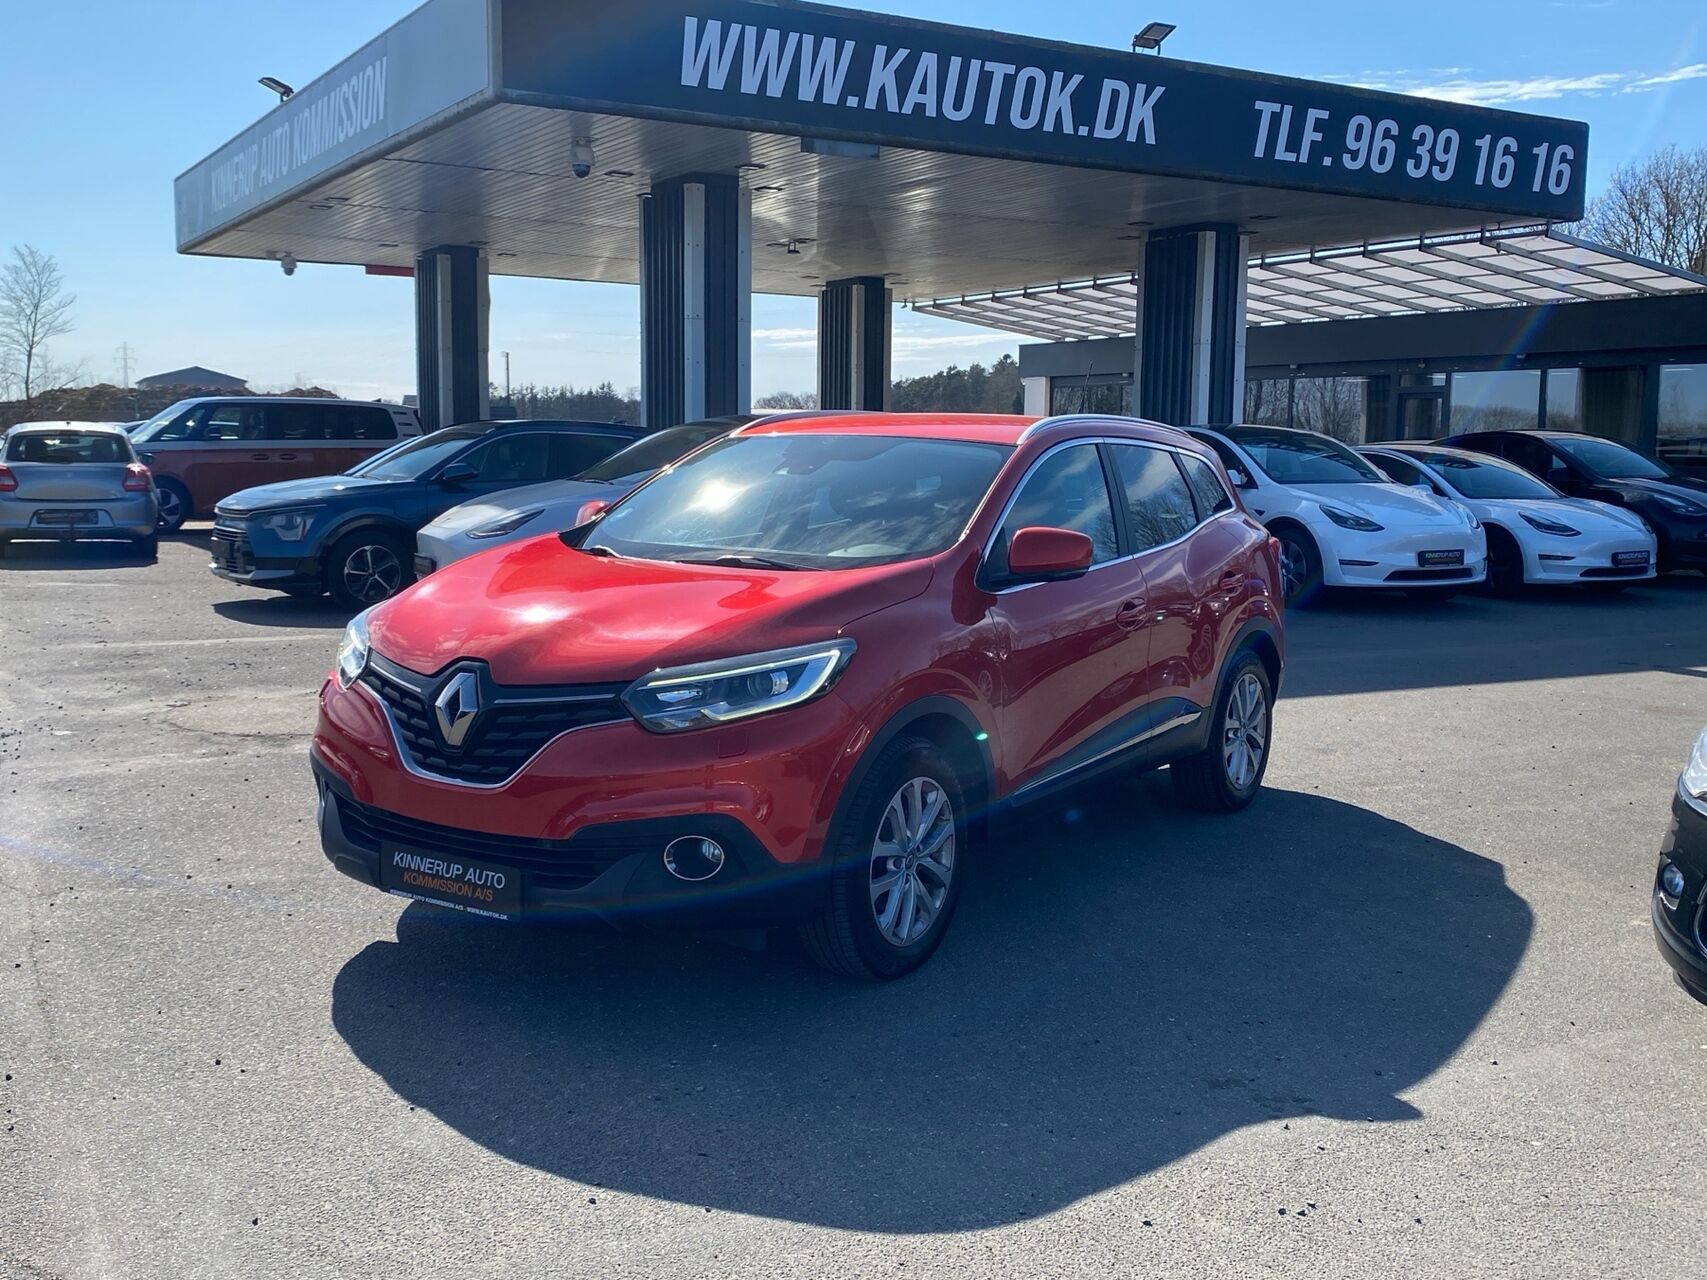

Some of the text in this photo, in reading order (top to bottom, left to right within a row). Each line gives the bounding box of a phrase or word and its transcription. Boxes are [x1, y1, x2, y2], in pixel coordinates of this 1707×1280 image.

[680, 16, 1166, 145] WWW.KAUTOK.DK
[211, 56, 387, 214] KINNERUP AUTO KOMMISSION
[1254, 100, 1574, 195] TLF. 96 39 16 16
[393, 851, 505, 888] KINNERUP AUTO
[403, 871, 493, 902] KOMMISSION A/S
